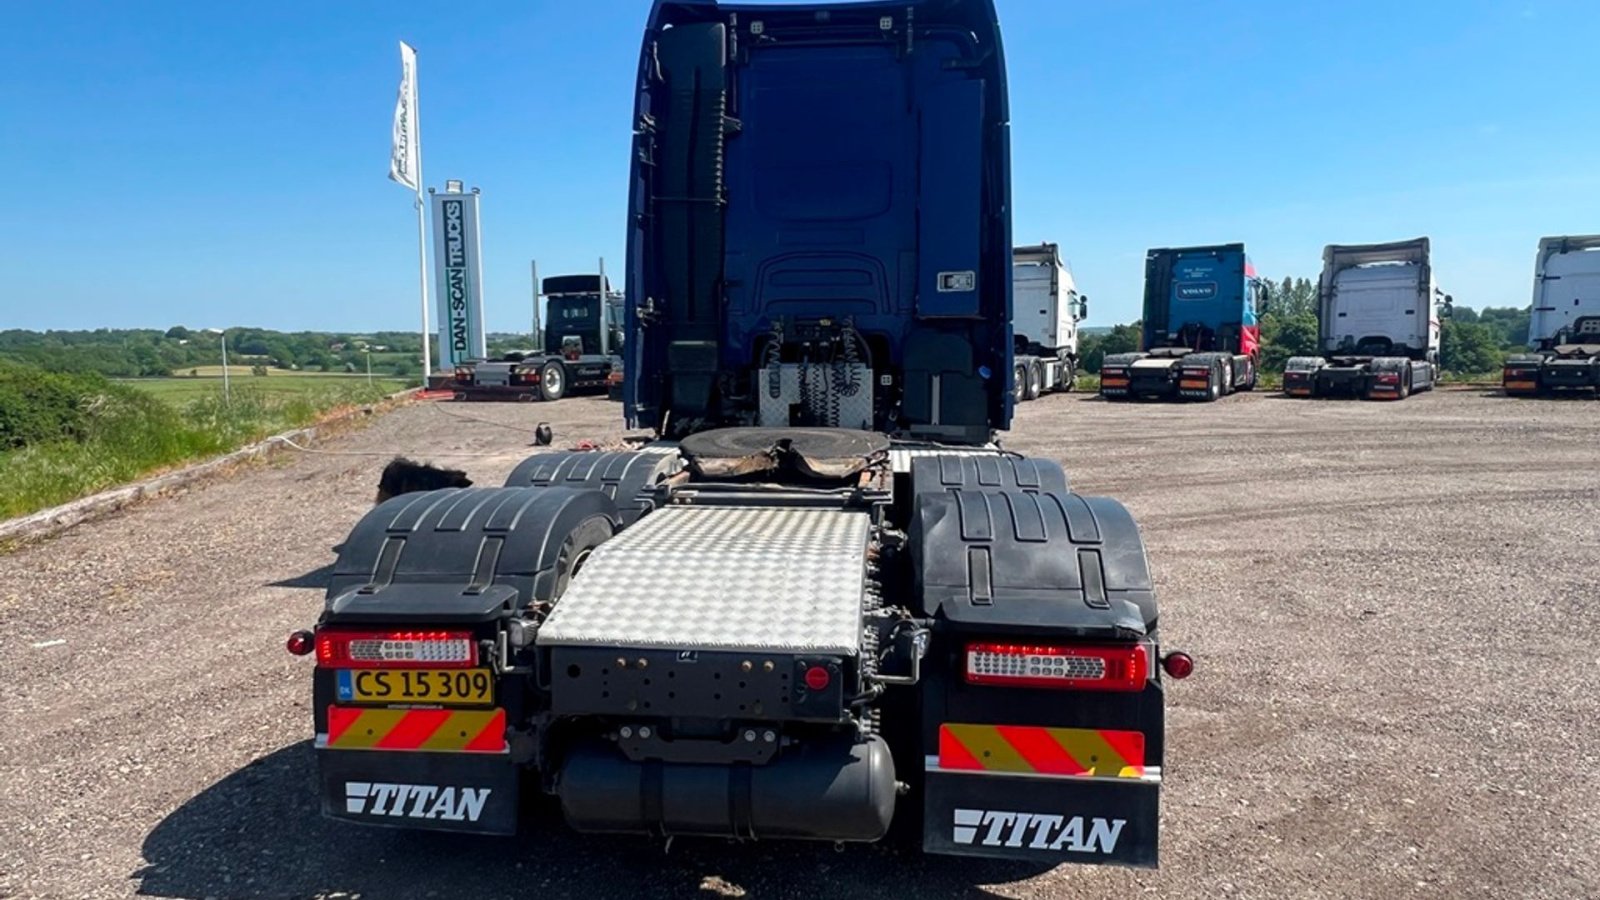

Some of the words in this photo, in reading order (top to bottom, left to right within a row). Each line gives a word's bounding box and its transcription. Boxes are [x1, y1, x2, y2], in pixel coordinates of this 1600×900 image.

[446, 201, 463, 266] TRUCKS
[355, 671, 392, 697] CS
[401, 671, 431, 697] 15
[437, 672, 488, 699] 309
[369, 783, 492, 822] TITAN
[982, 810, 1127, 854] TITAN
